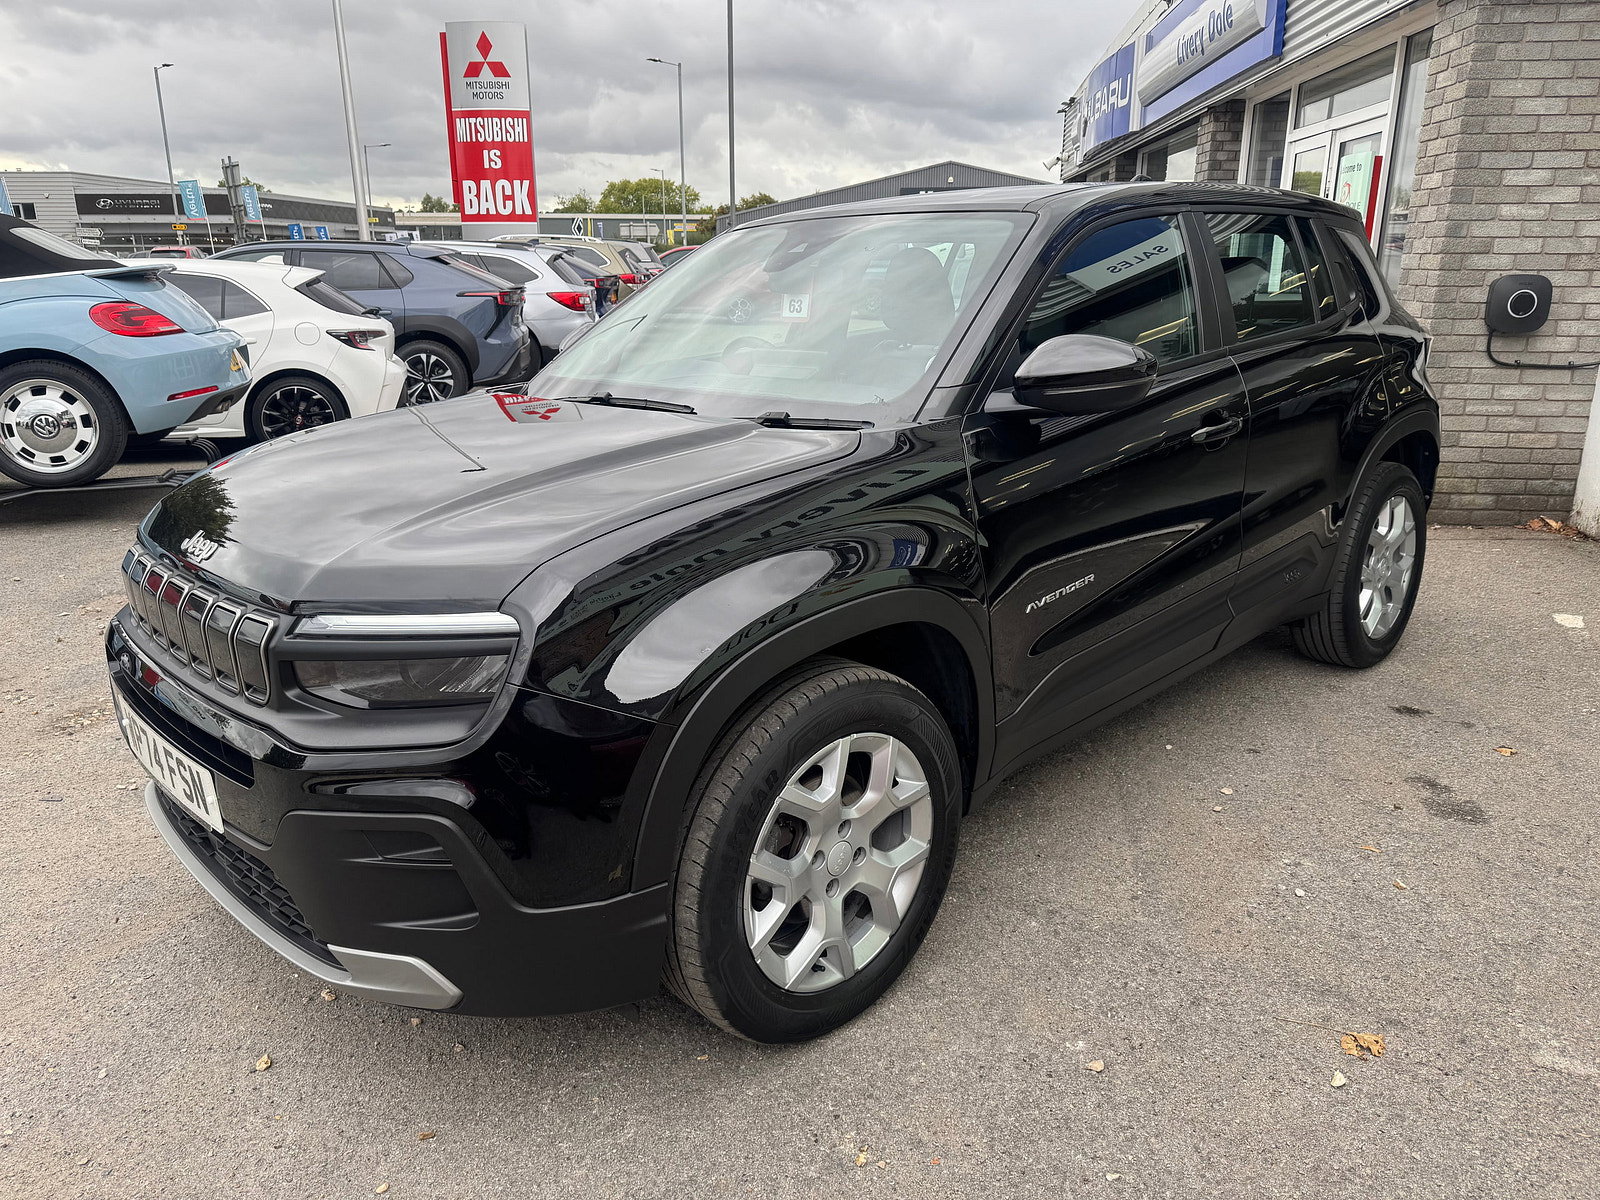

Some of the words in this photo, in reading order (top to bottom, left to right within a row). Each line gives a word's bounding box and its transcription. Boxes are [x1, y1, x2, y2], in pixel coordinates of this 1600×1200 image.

[1177, 26, 1204, 65] Livery
[1208, 0, 1233, 42] Dole
[465, 81, 510, 90] MITSUBISHI
[472, 91, 504, 100] MOTORS
[455, 117, 528, 142] MITSUBISHI
[482, 149, 502, 169] IS
[462, 179, 532, 215] BACK
[789, 299, 802, 313] 63
[181, 530, 219, 562] Jeep
[1026, 574, 1095, 613] AVENGER
[163, 746, 209, 816] FSN
